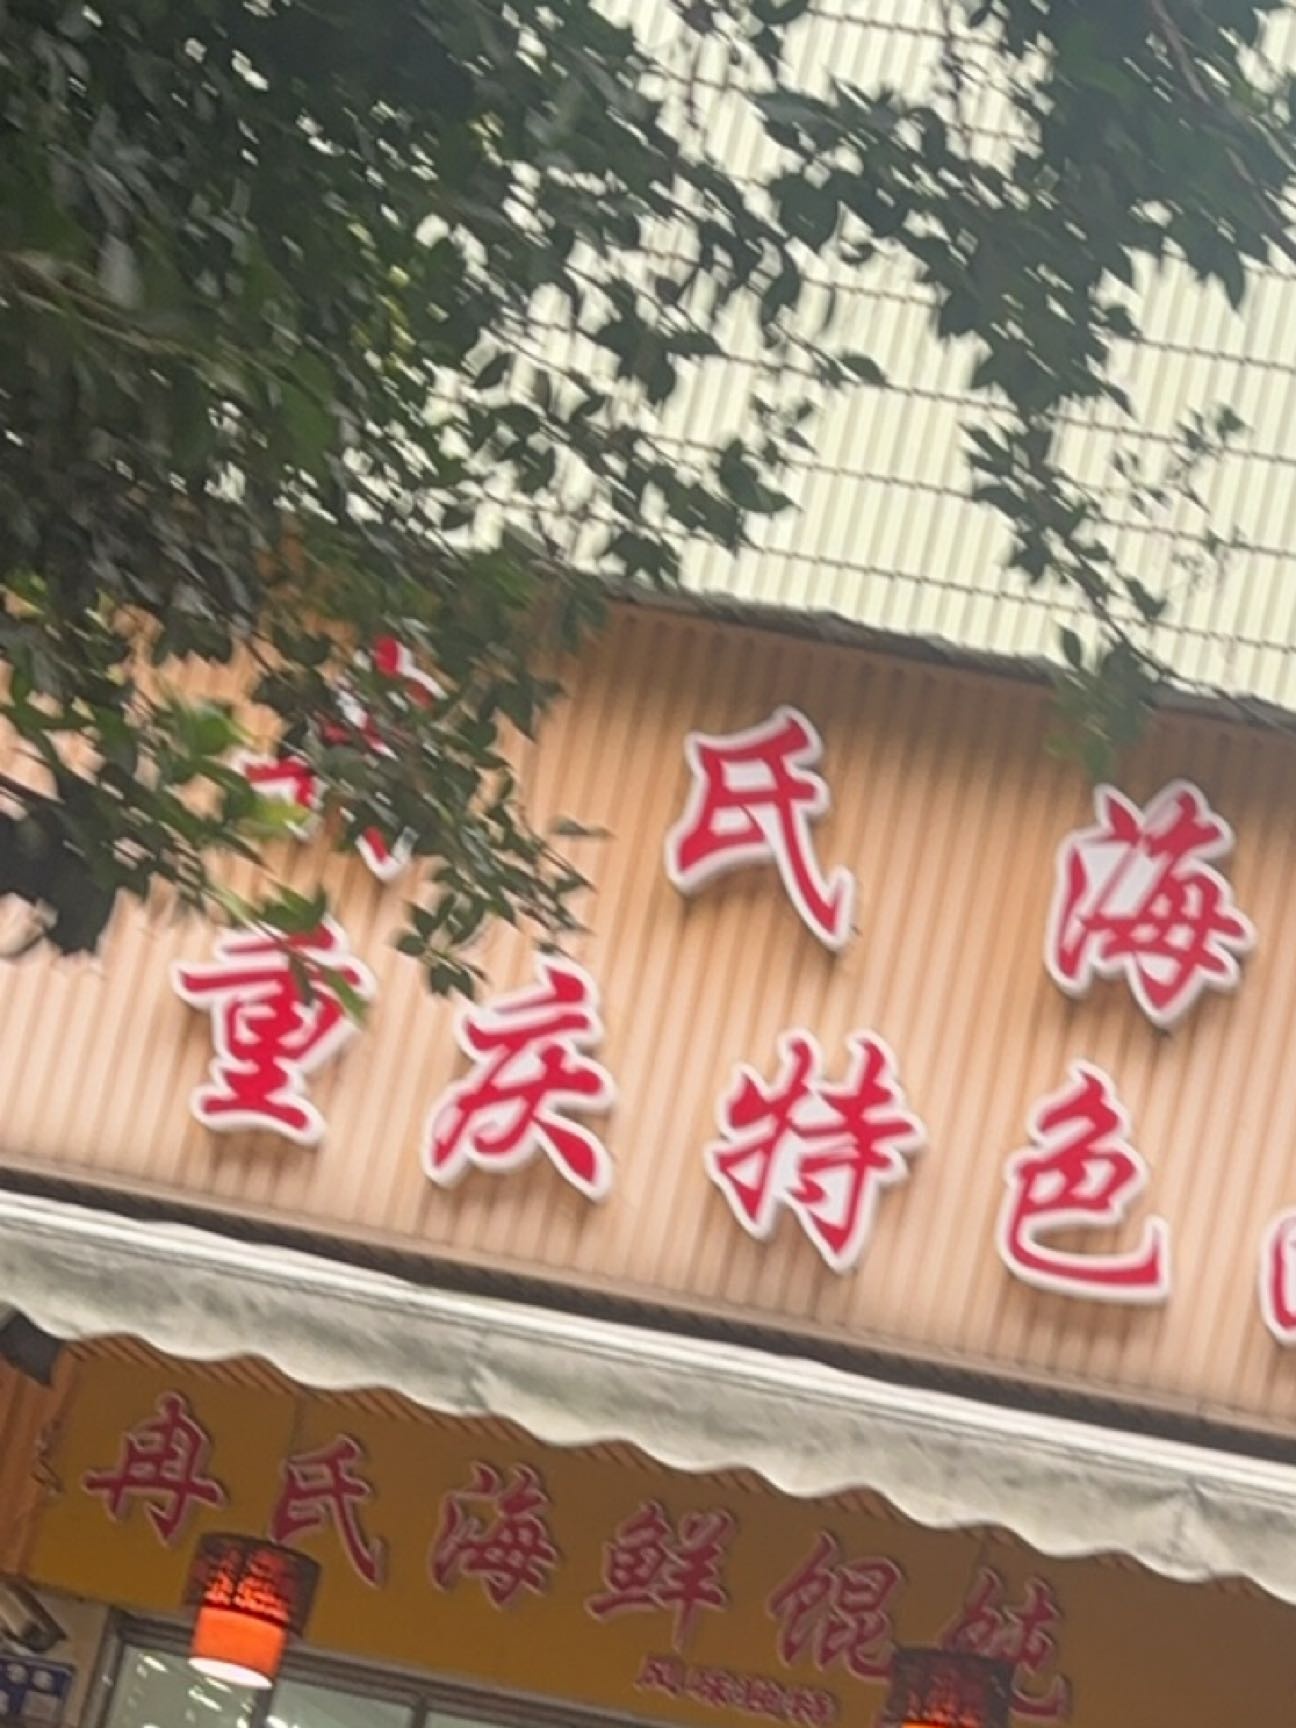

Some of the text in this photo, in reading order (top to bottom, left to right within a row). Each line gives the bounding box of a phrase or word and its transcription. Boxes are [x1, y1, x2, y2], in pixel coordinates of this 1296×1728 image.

[82, 1390, 1074, 1722] 冉氏海鲜馄饨
